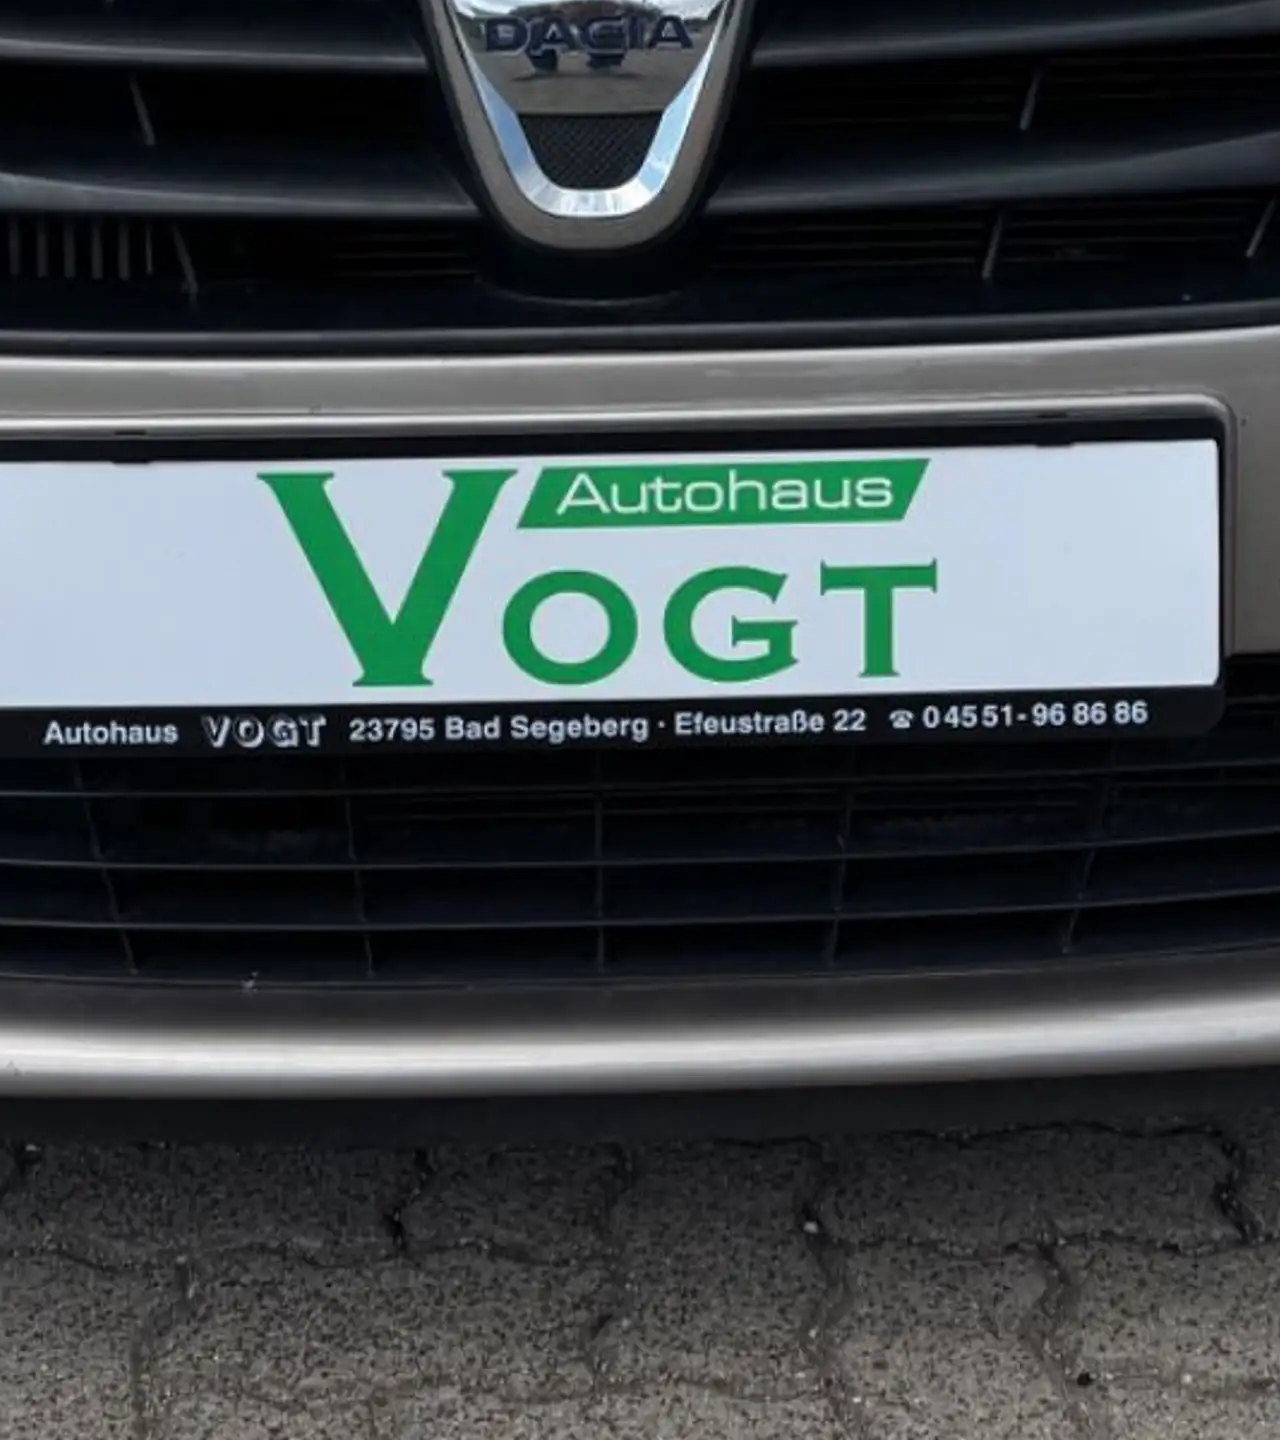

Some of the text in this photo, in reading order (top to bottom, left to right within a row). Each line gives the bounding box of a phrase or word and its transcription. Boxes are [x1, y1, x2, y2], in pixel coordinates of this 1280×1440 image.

[484, 15, 694, 54] DACIA
[556, 472, 893, 516] Autohaus
[43, 720, 179, 745] Autohaus
[201, 714, 327, 748] VOGT
[349, 717, 435, 741] 23795
[445, 716, 500, 740] Bad
[510, 714, 649, 743] Segeberg
[674, 709, 825, 736] Efeustraße
[833, 708, 867, 732] 22
